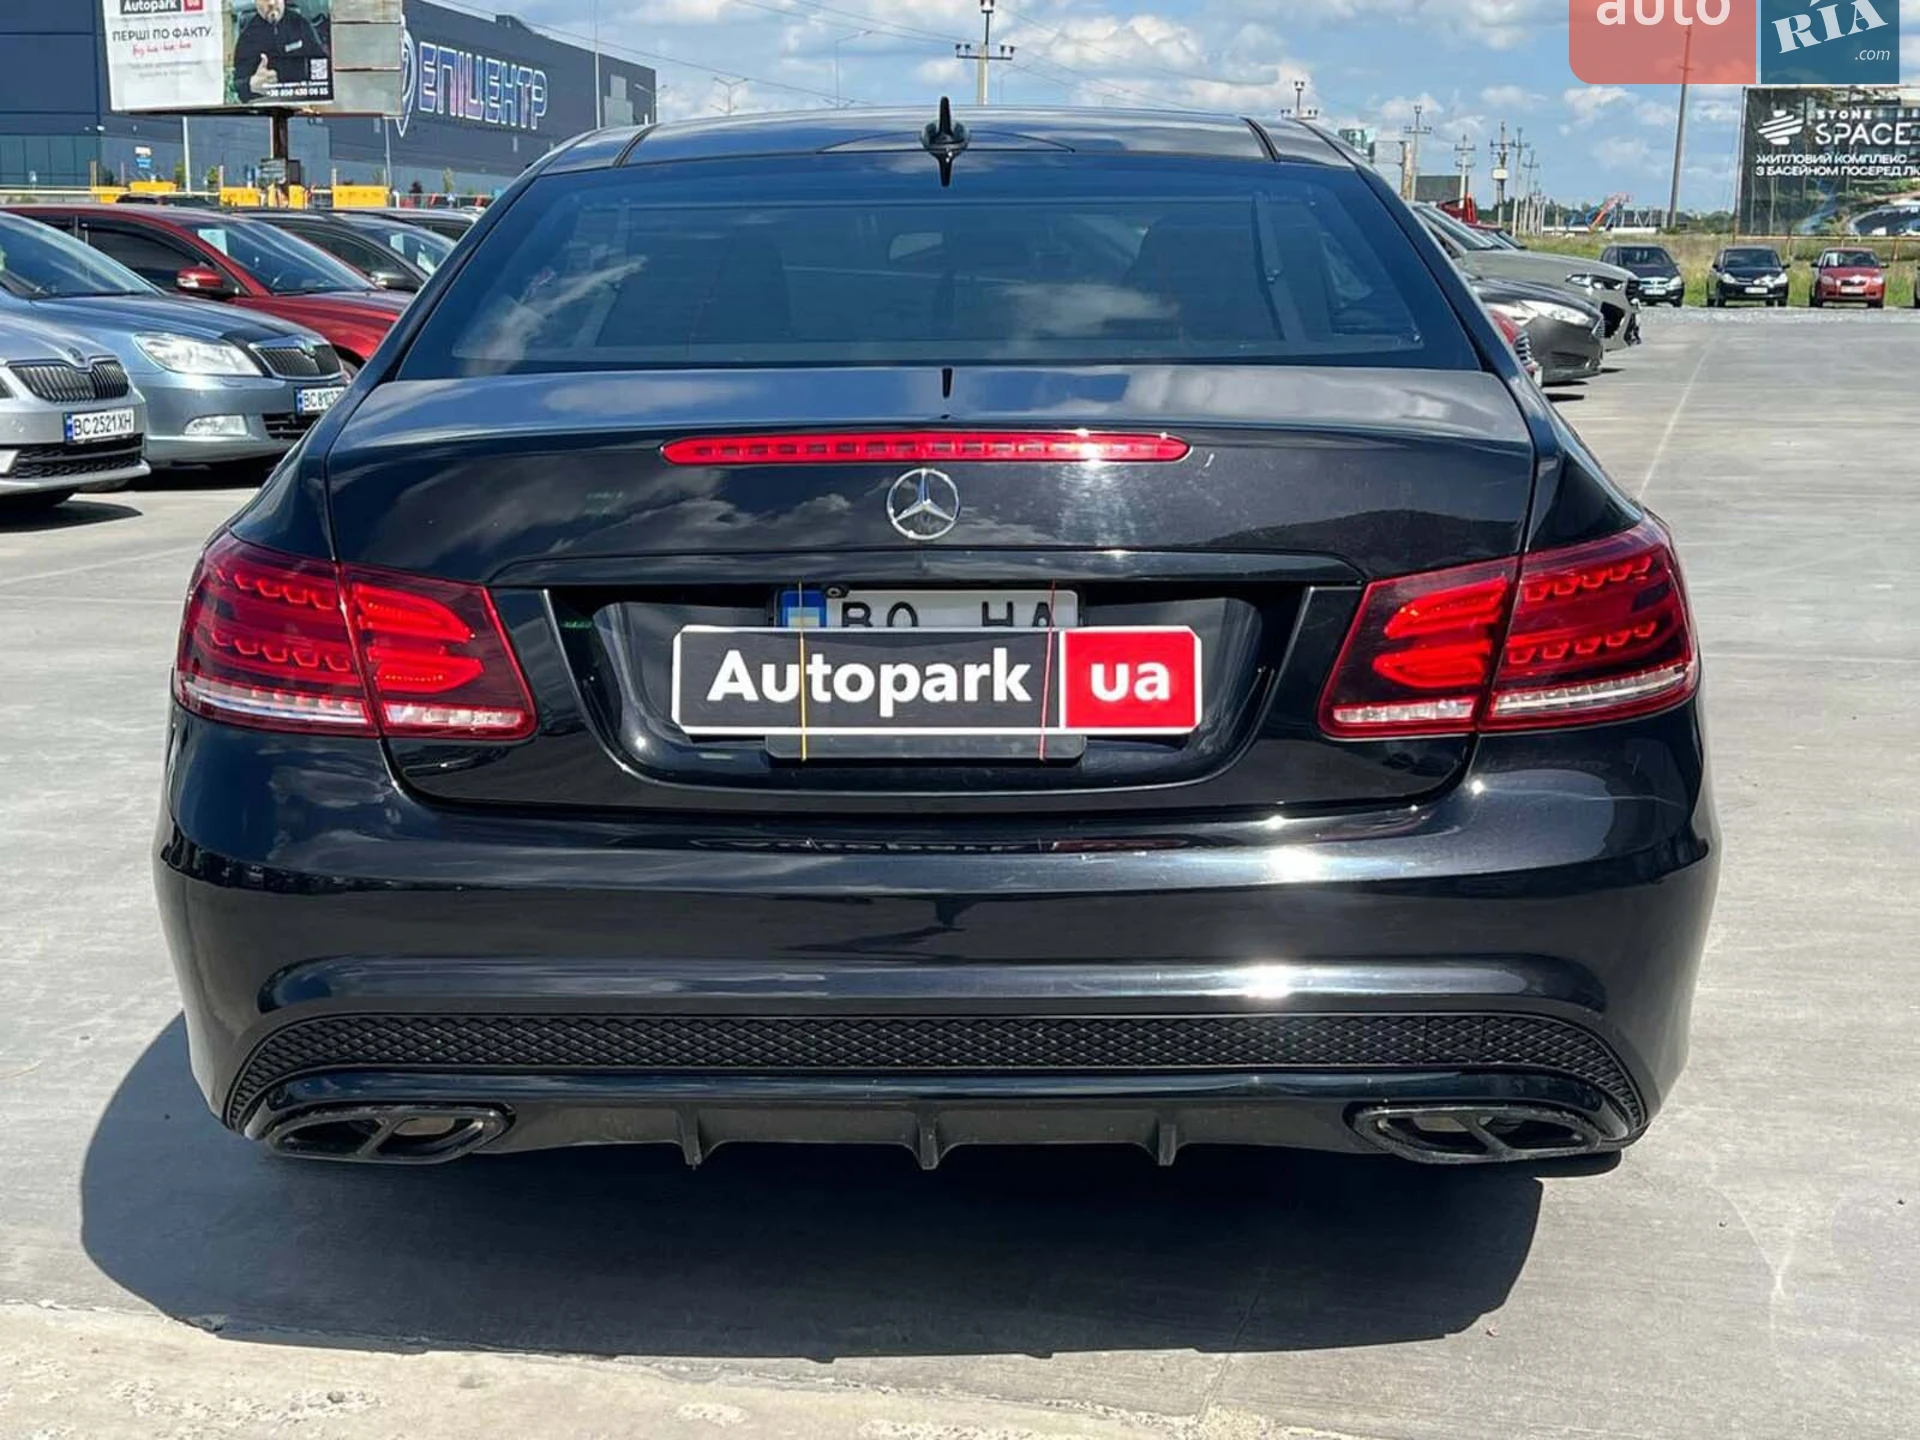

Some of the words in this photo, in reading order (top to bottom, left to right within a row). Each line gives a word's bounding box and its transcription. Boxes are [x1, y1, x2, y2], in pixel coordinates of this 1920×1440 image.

[112, 29, 150, 42] ПЕРШІ
[153, 28, 170, 40] ПО
[172, 26, 212, 39] ФАКТУ
[418, 41, 548, 131] ЕПІЦЕНТР
[1816, 109, 1873, 120] STONE
[1814, 122, 1913, 146] SPACE
[1756, 153, 1832, 165] ЖИТЛОВИЙ
[1834, 153, 1908, 165] КОМПЛЕКС
[1766, 164, 1839, 177] БАСЕЙНОМ
[1841, 165, 1902, 177] ПОСЕРЕД
[707, 647, 1032, 717] Autopark
[1090, 661, 1171, 702] ua
